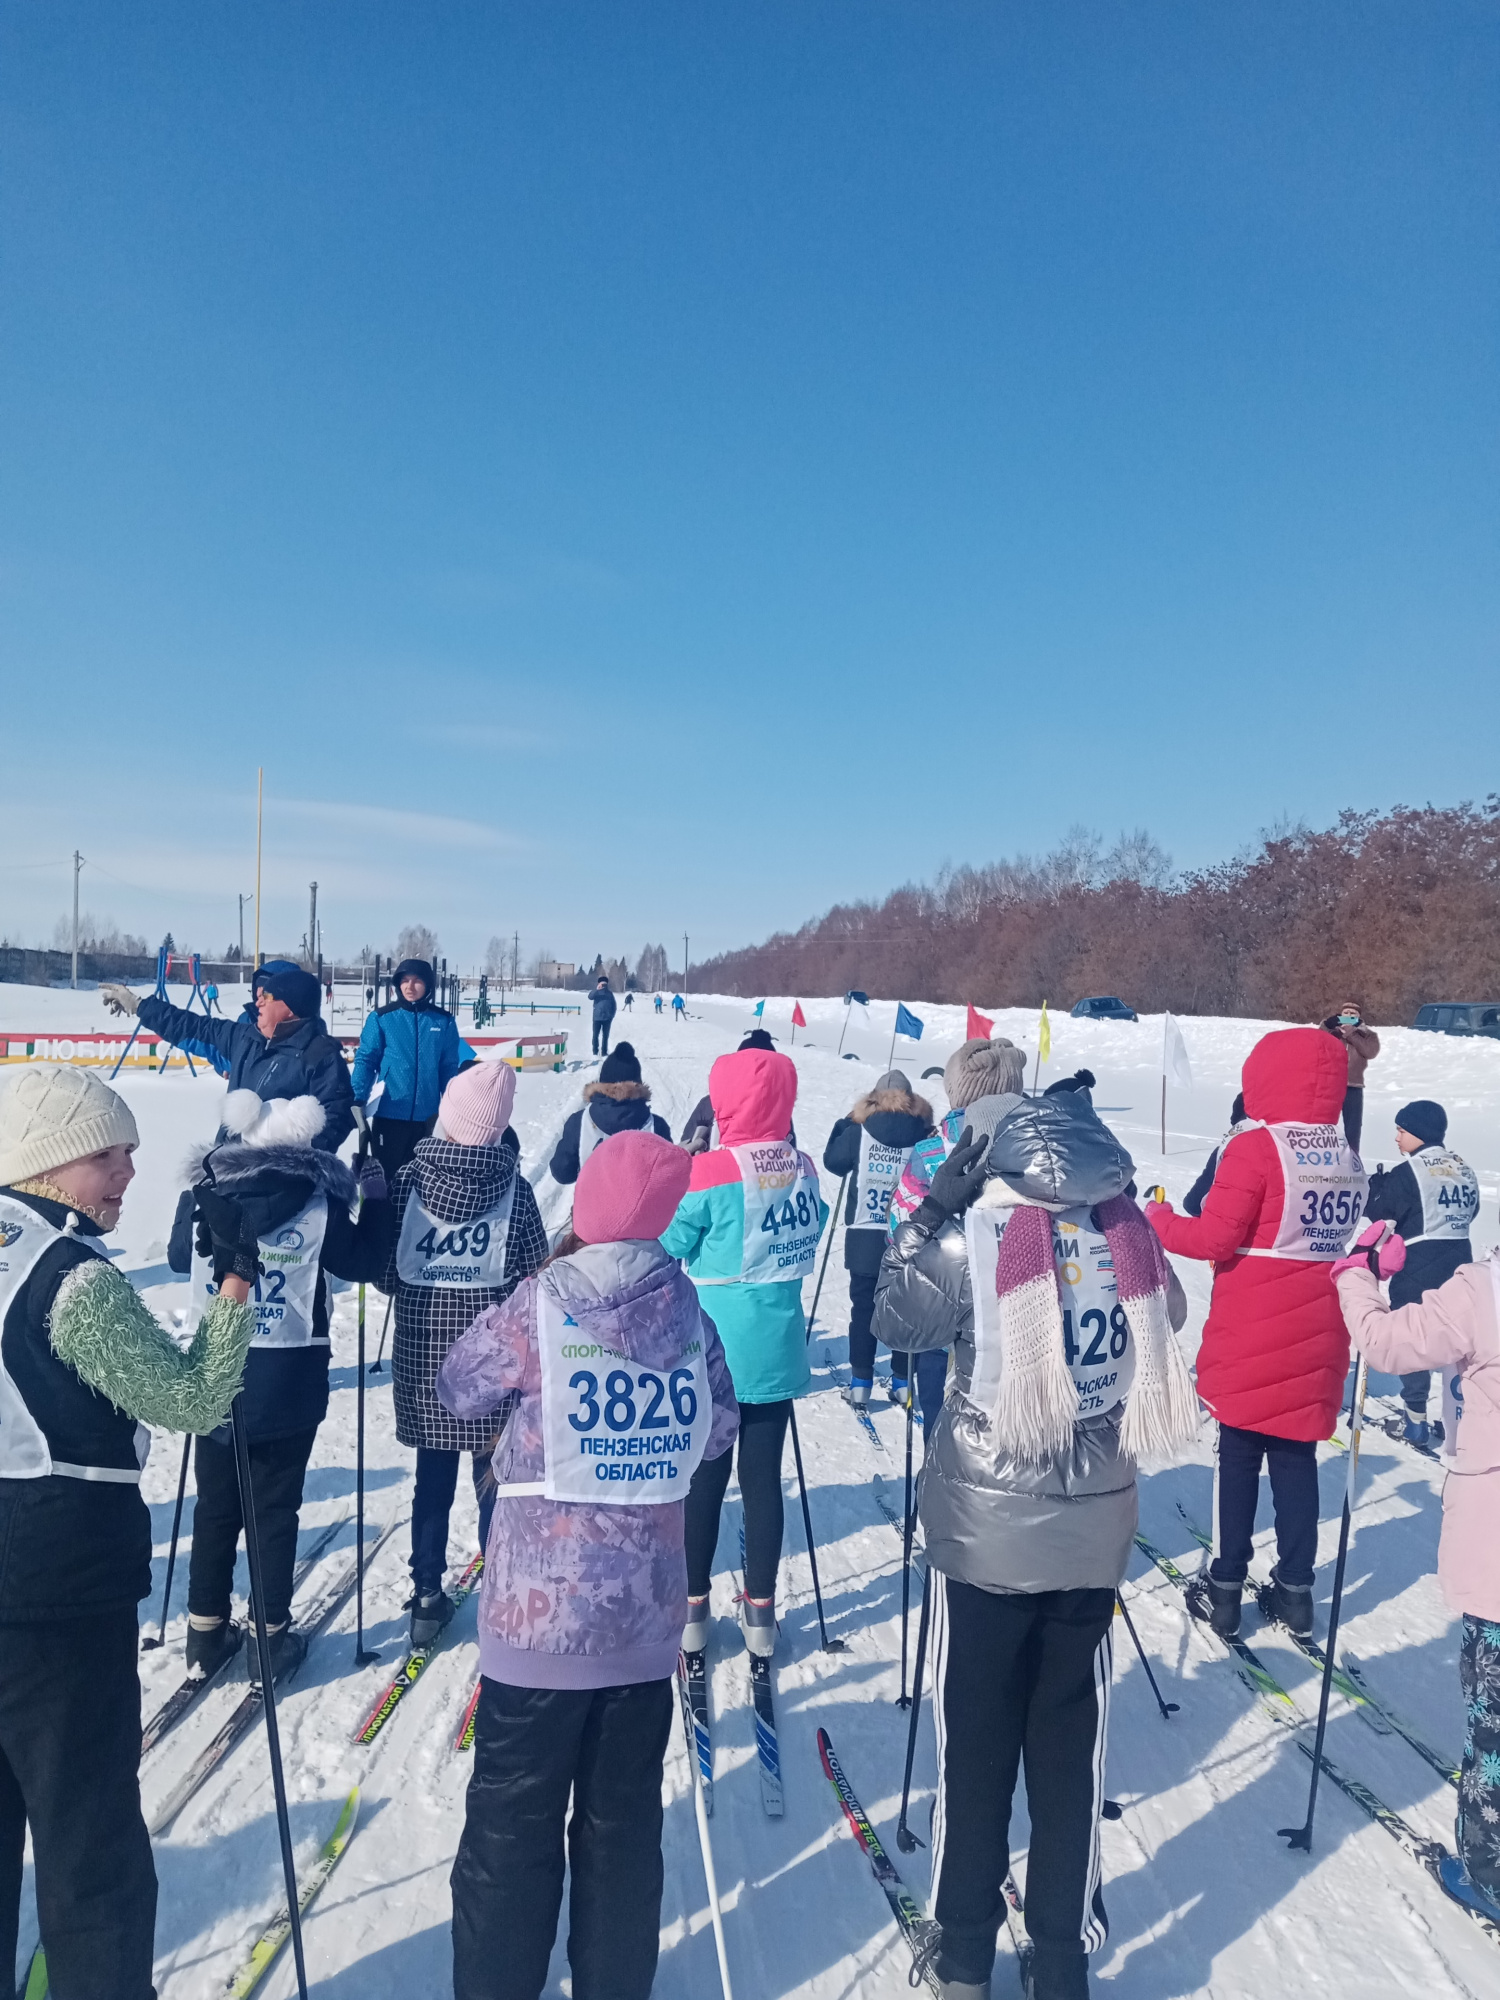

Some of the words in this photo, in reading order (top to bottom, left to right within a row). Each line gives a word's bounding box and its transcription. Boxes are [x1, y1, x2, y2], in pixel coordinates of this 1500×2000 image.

[30, 1038, 140, 1061] ЛЮБИМ
[868, 1144, 902, 1155] ЛЫЖНЯ
[1288, 1136, 1339, 1150] РОССИИ
[754, 1159, 796, 1173] НАЦИИ
[868, 1153, 902, 1164] РОССИИ
[1295, 1151, 1340, 1166] 2021
[868, 1162, 898, 1175] 2021
[761, 1187, 819, 1236] 4481
[1300, 1190, 1362, 1226] 3656
[267, 1251, 302, 1264] ЖИЗНИ
[778, 1247, 816, 1267] ОБЛАСТЬ
[422, 1270, 473, 1282] ОБЛАСТЬ
[561, 1344, 604, 1359] СПОРТ
[568, 1368, 698, 1432] 3826
[580, 1432, 691, 1457] ПЕНЗЕНСКАЯ
[595, 1460, 678, 1482] ОБЛАСТЬ
